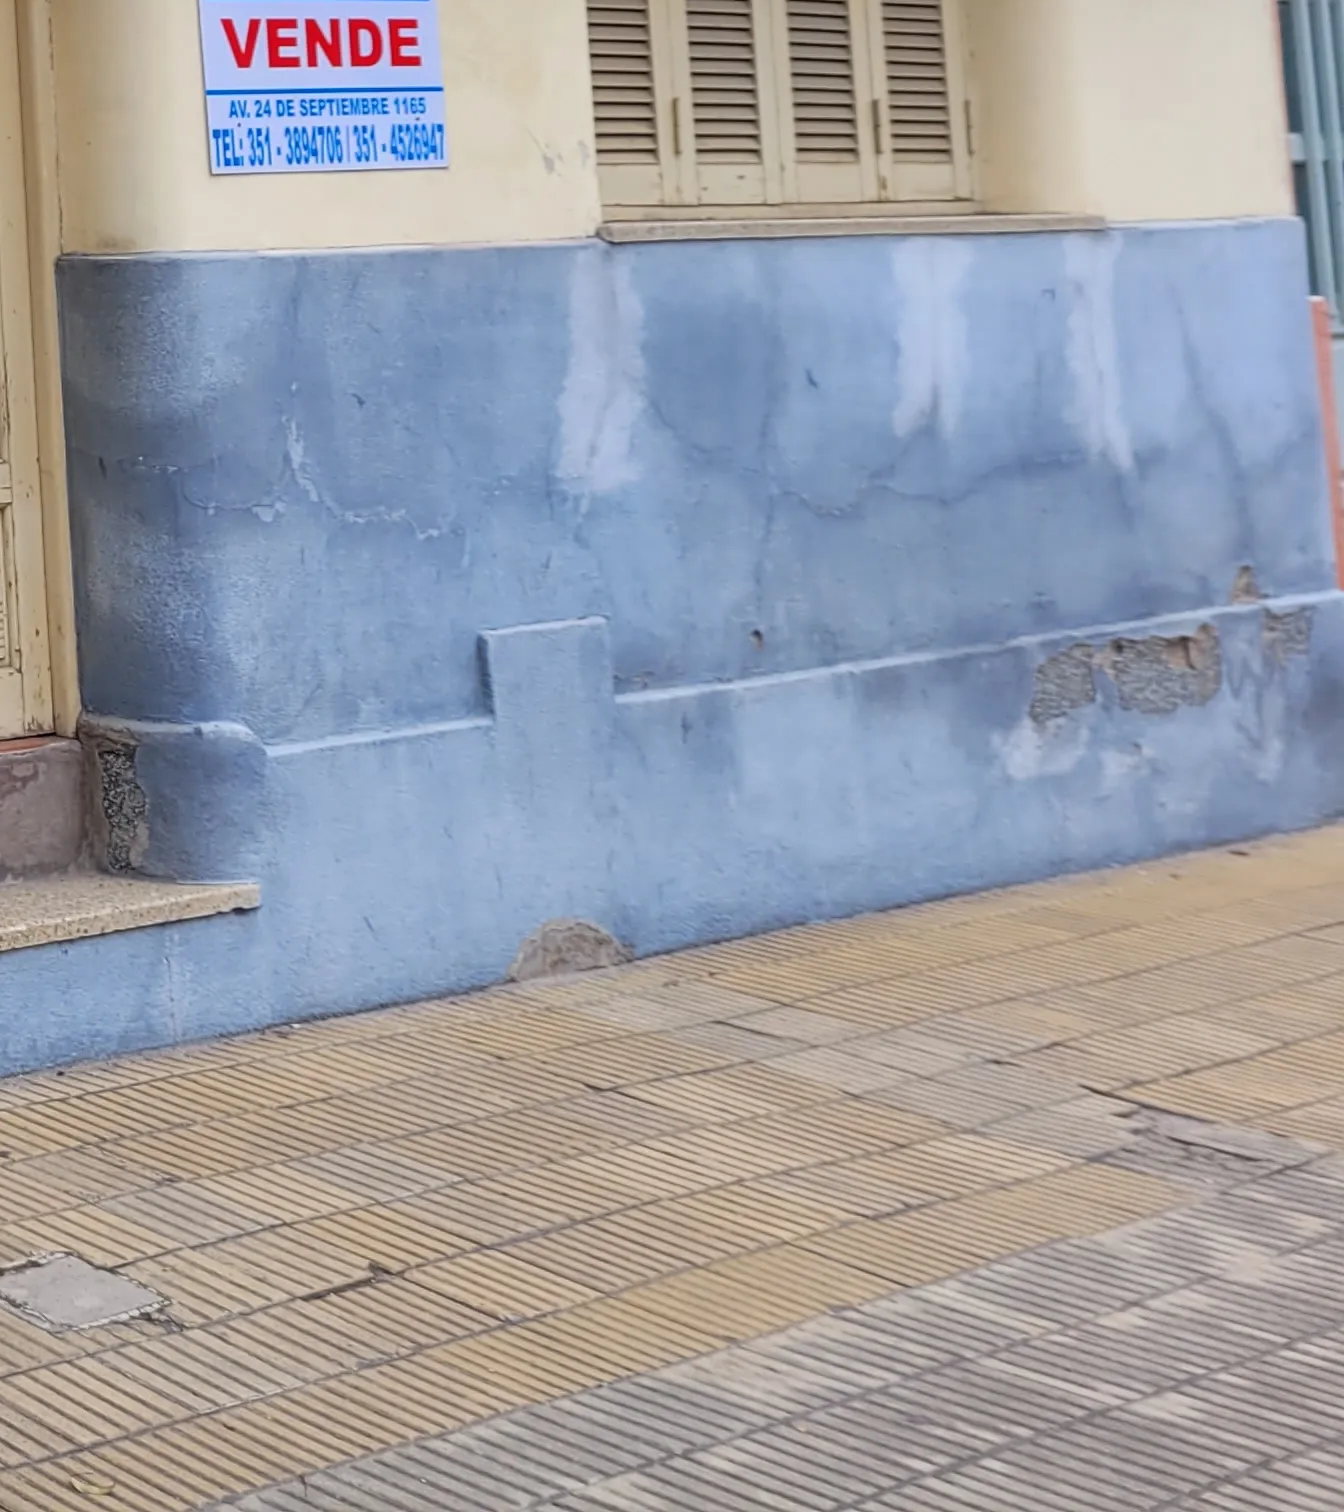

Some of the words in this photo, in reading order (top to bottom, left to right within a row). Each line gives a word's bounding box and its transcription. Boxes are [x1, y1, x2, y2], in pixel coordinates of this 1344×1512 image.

[220, 18, 422, 68] VENDE
[229, 100, 250, 118] AV.
[255, 99, 272, 117] 24
[276, 99, 295, 117] DE
[300, 97, 390, 117] SEPTIEMBRE
[394, 97, 427, 115] 1165
[212, 128, 244, 167] TEL:
[247, 126, 273, 166] 351
[284, 124, 343, 165] 3894706
[353, 124, 378, 163] 351
